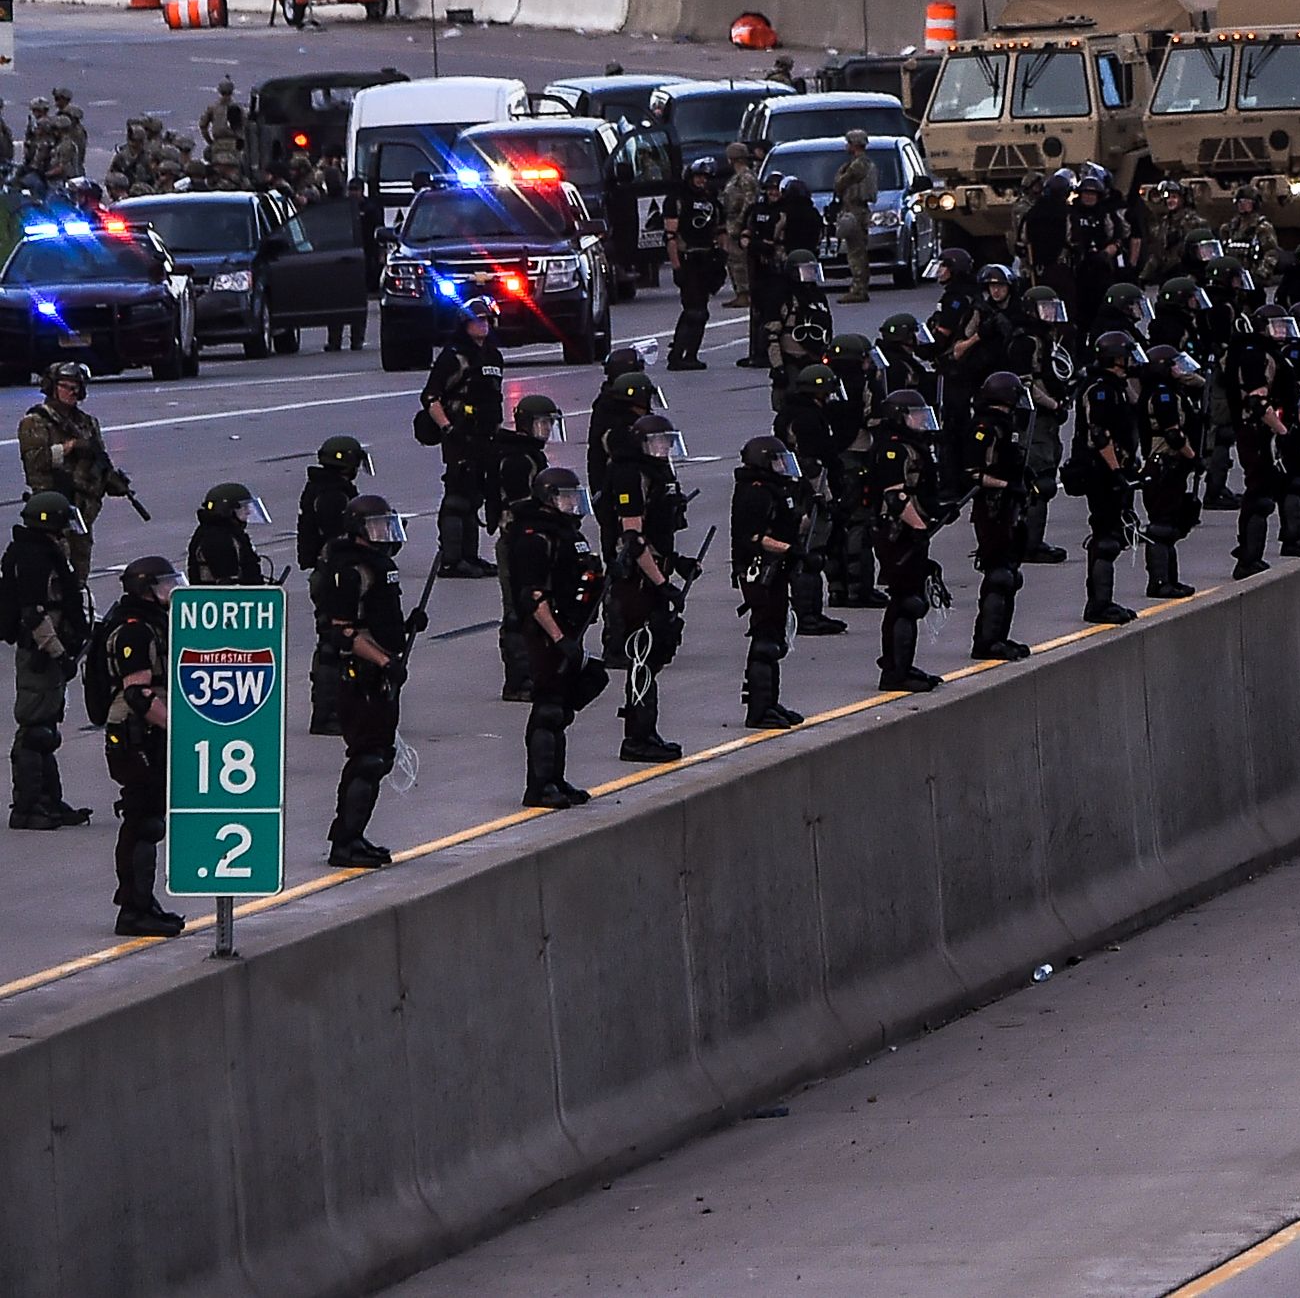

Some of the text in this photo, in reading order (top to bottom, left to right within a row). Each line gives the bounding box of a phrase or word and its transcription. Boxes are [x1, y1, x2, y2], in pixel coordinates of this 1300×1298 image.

[180, 601, 274, 630] NORTH
[200, 652, 253, 663] INTERSTATE
[189, 670, 265, 706] 35W
[194, 739, 256, 795] 18
[197, 823, 252, 878] .2
